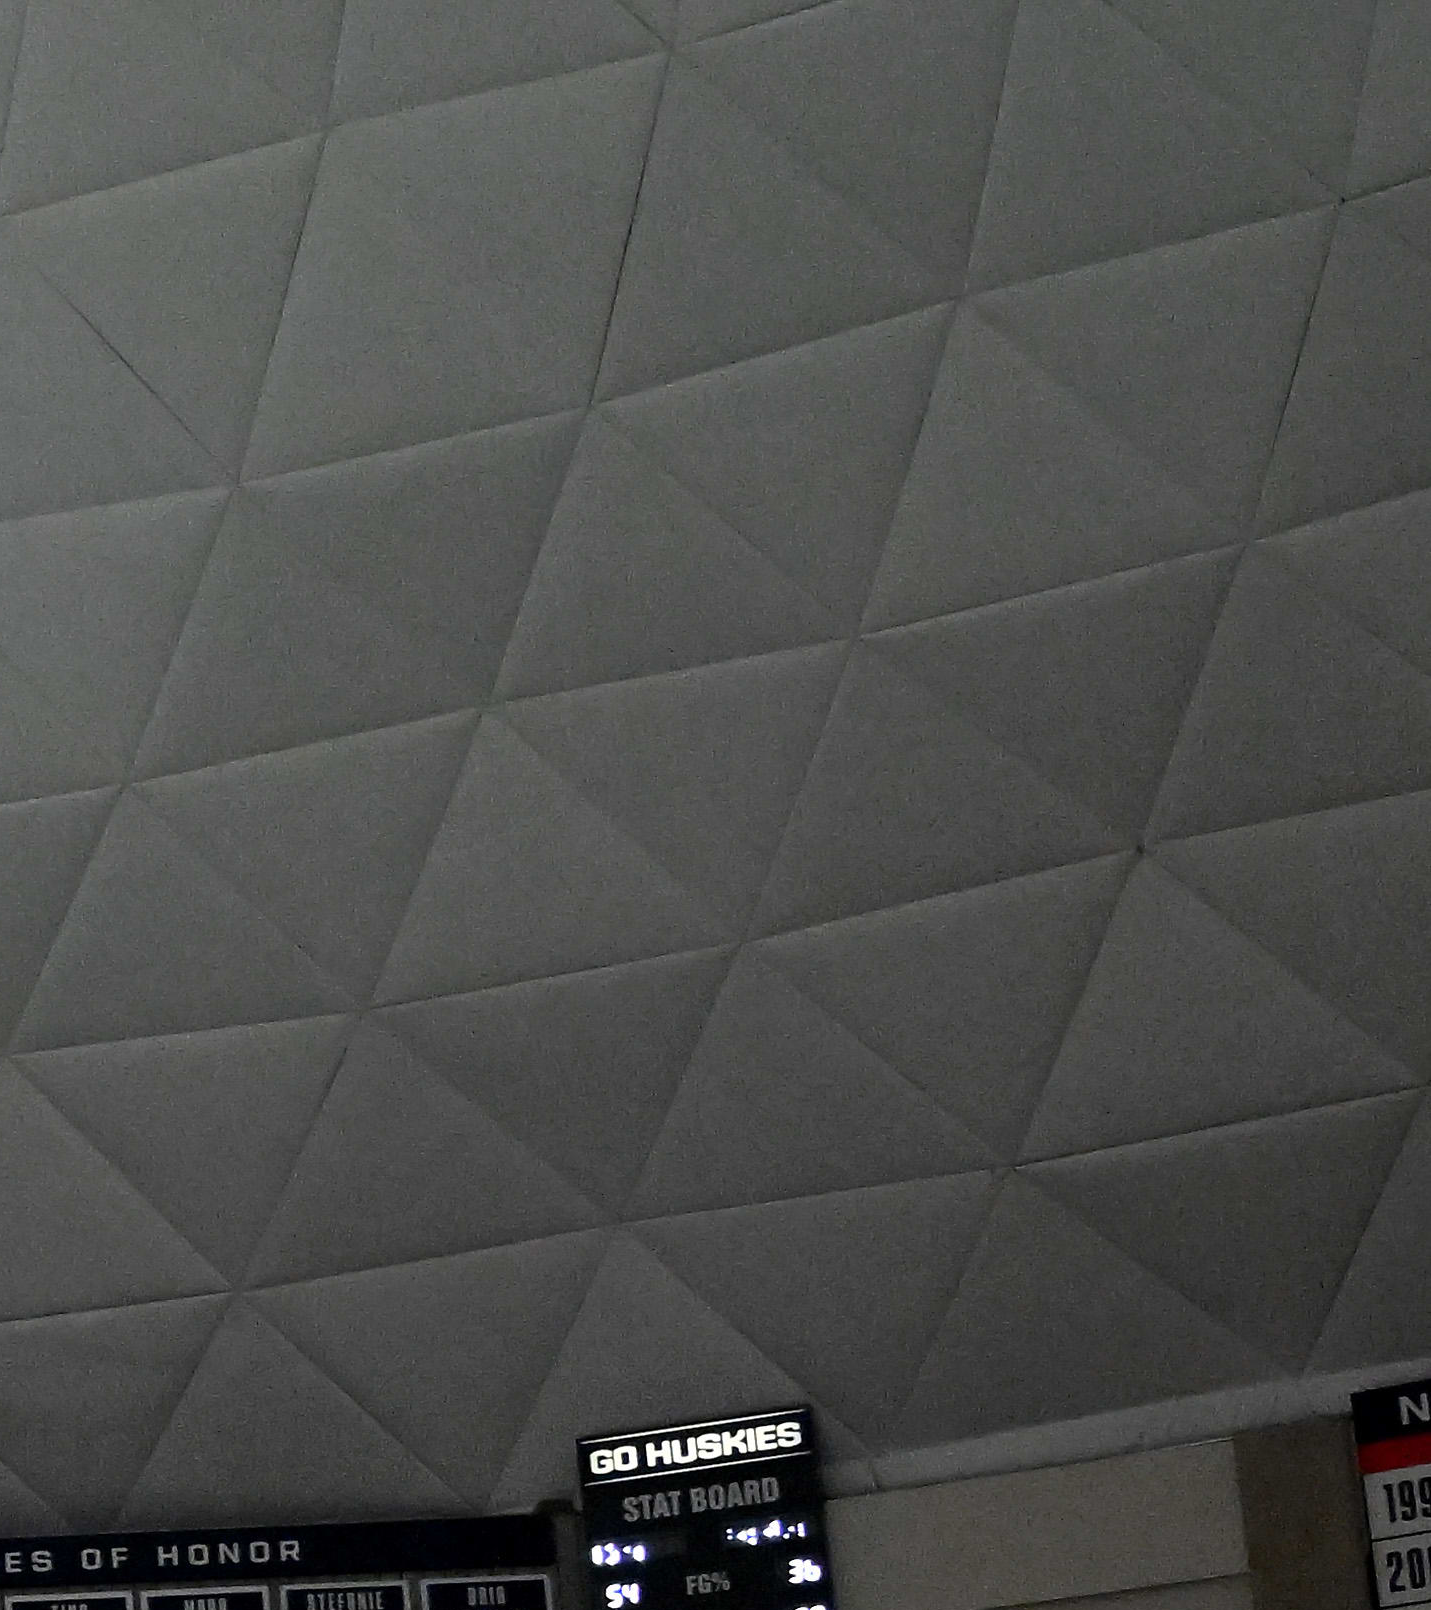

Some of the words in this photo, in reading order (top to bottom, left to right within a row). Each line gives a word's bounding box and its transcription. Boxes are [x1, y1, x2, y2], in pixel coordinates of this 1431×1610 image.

[590, 1446, 638, 1475] GO
[645, 1422, 802, 1467] HUSKIES
[623, 1490, 681, 1522] STAT
[690, 1477, 780, 1513] BOARD
[81, 1547, 129, 1570] OF
[157, 1540, 300, 1568] HONOR
[686, 1572, 731, 1596] FG%
